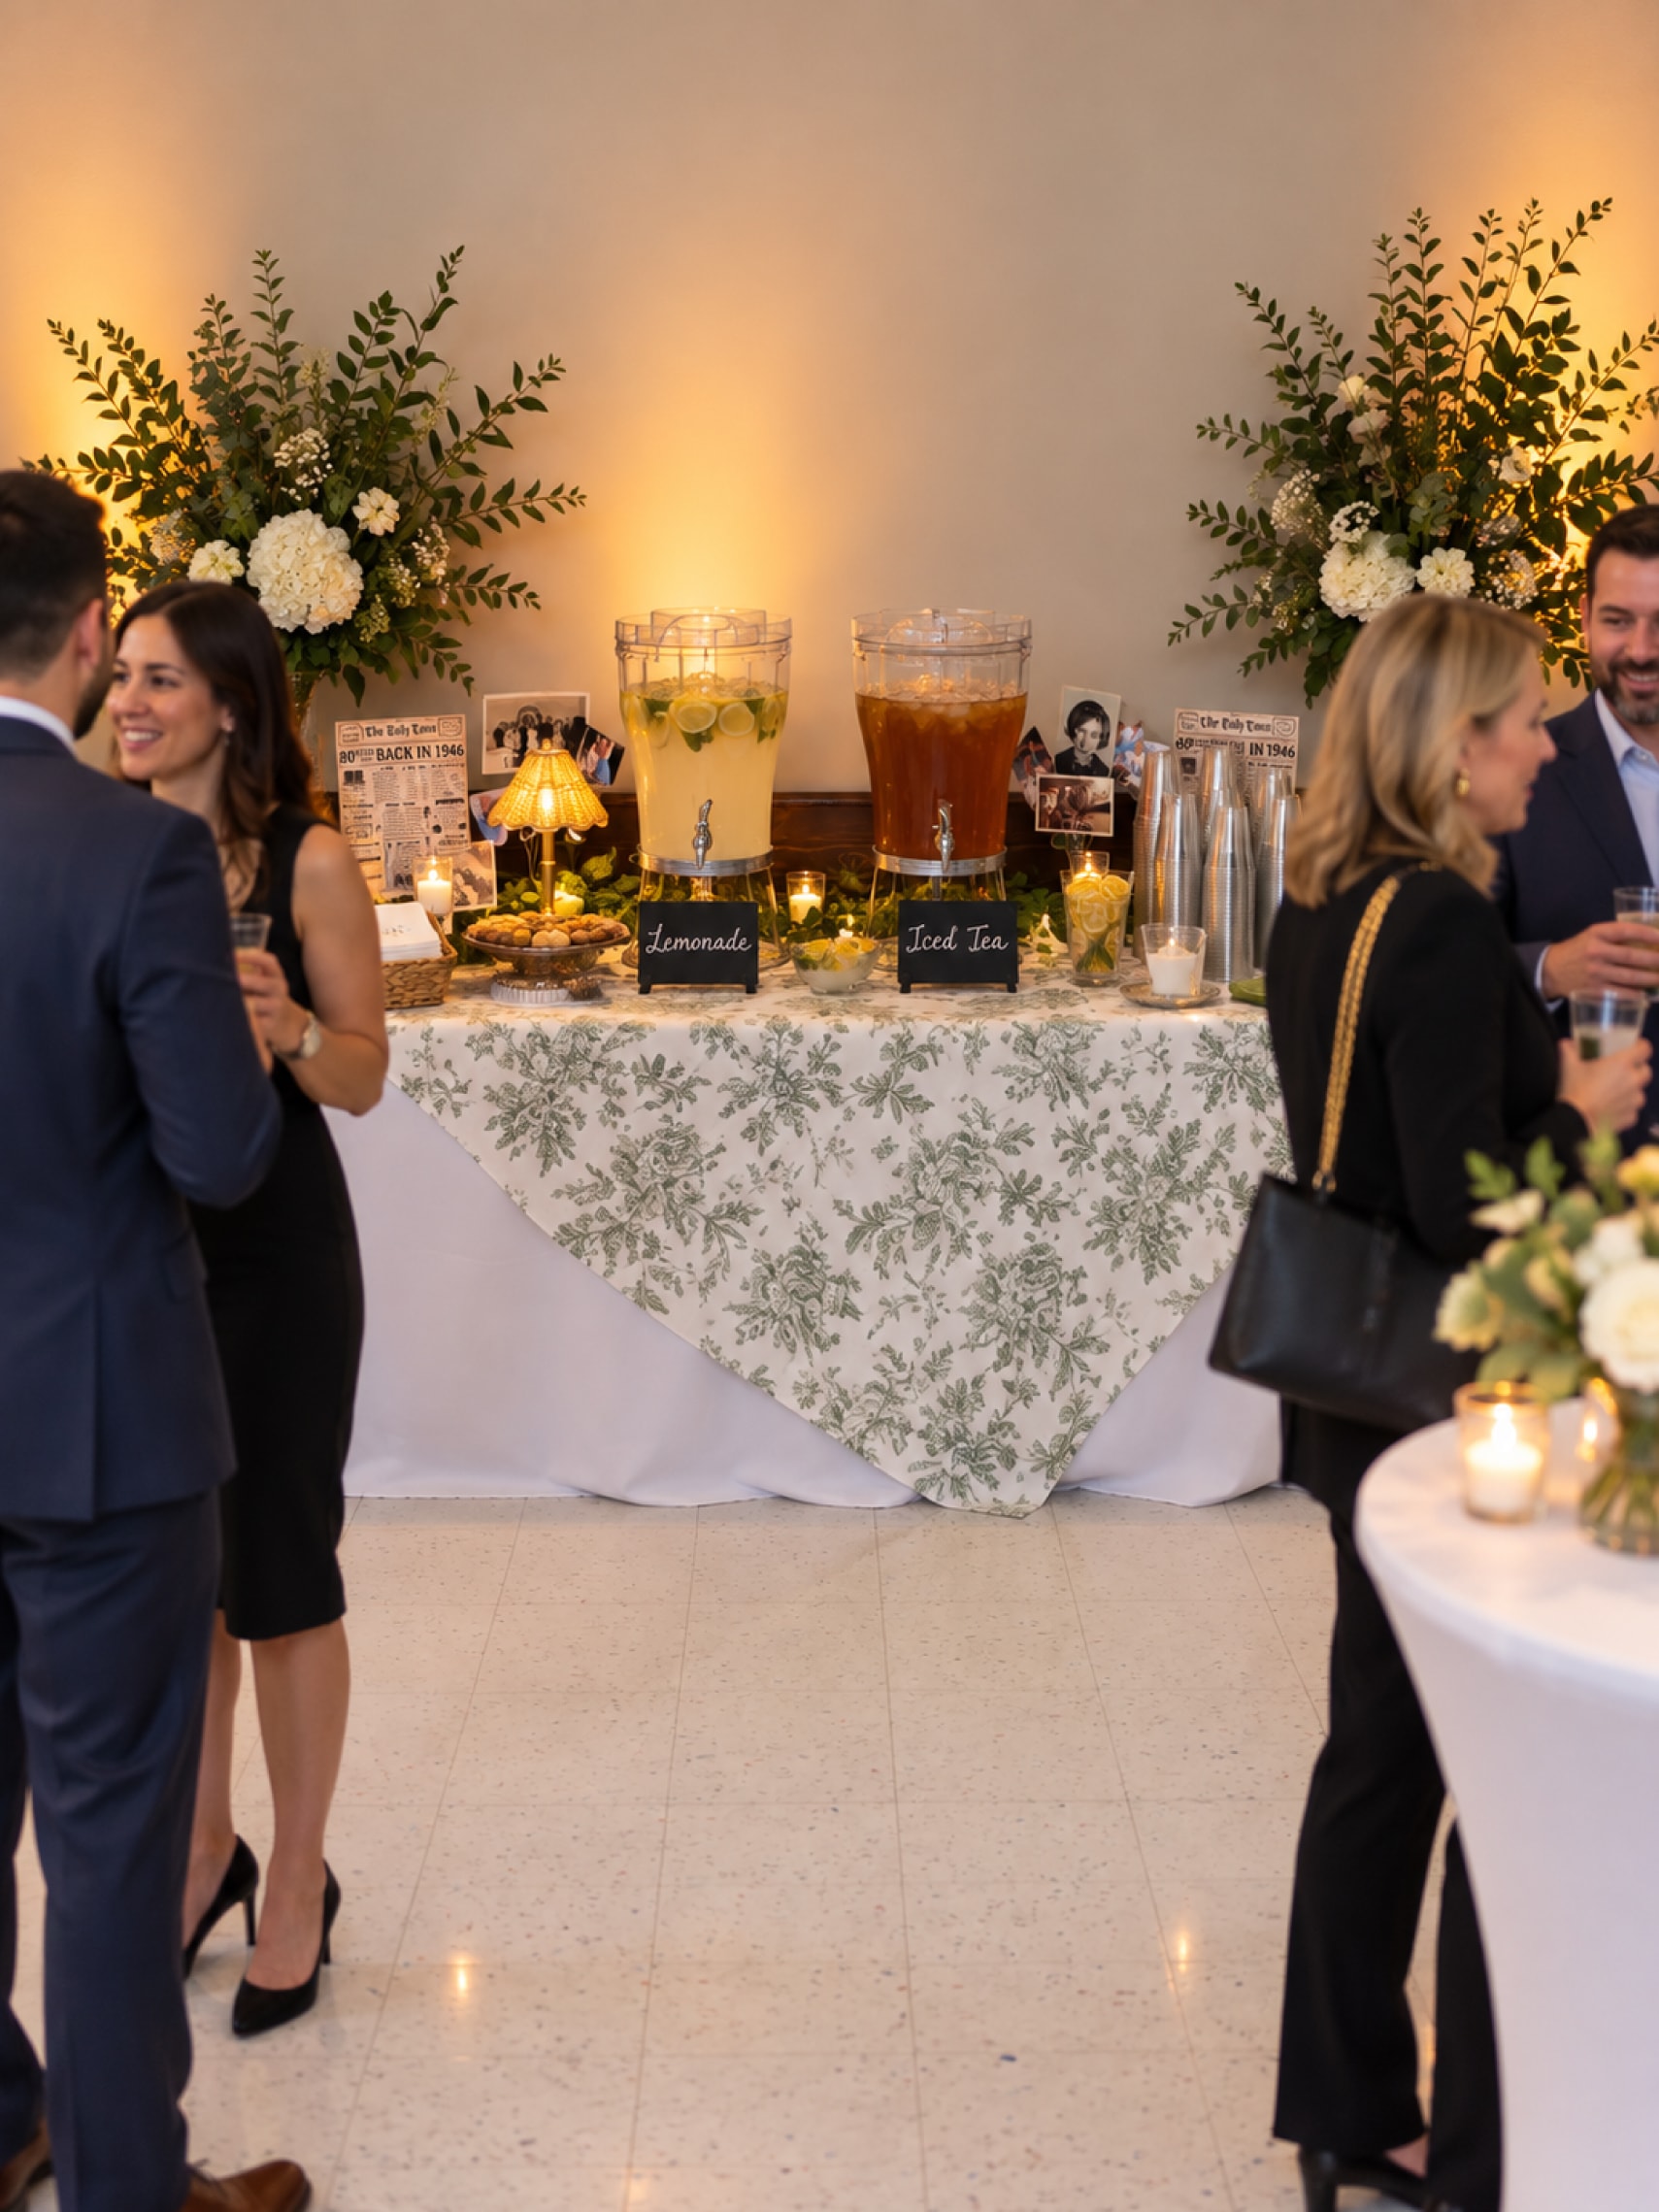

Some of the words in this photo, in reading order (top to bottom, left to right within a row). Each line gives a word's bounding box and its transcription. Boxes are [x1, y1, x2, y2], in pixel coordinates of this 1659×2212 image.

[340, 750, 355, 764] 80
[376, 745, 414, 761] BACK
[416, 744, 432, 759] IN
[435, 743, 464, 758] 1946
[1249, 742, 1264, 756] IN
[1266, 743, 1296, 758] 1946
[645, 923, 752, 954] Lemonade
[906, 924, 959, 953] Iced
[966, 924, 1010, 953] Tea
